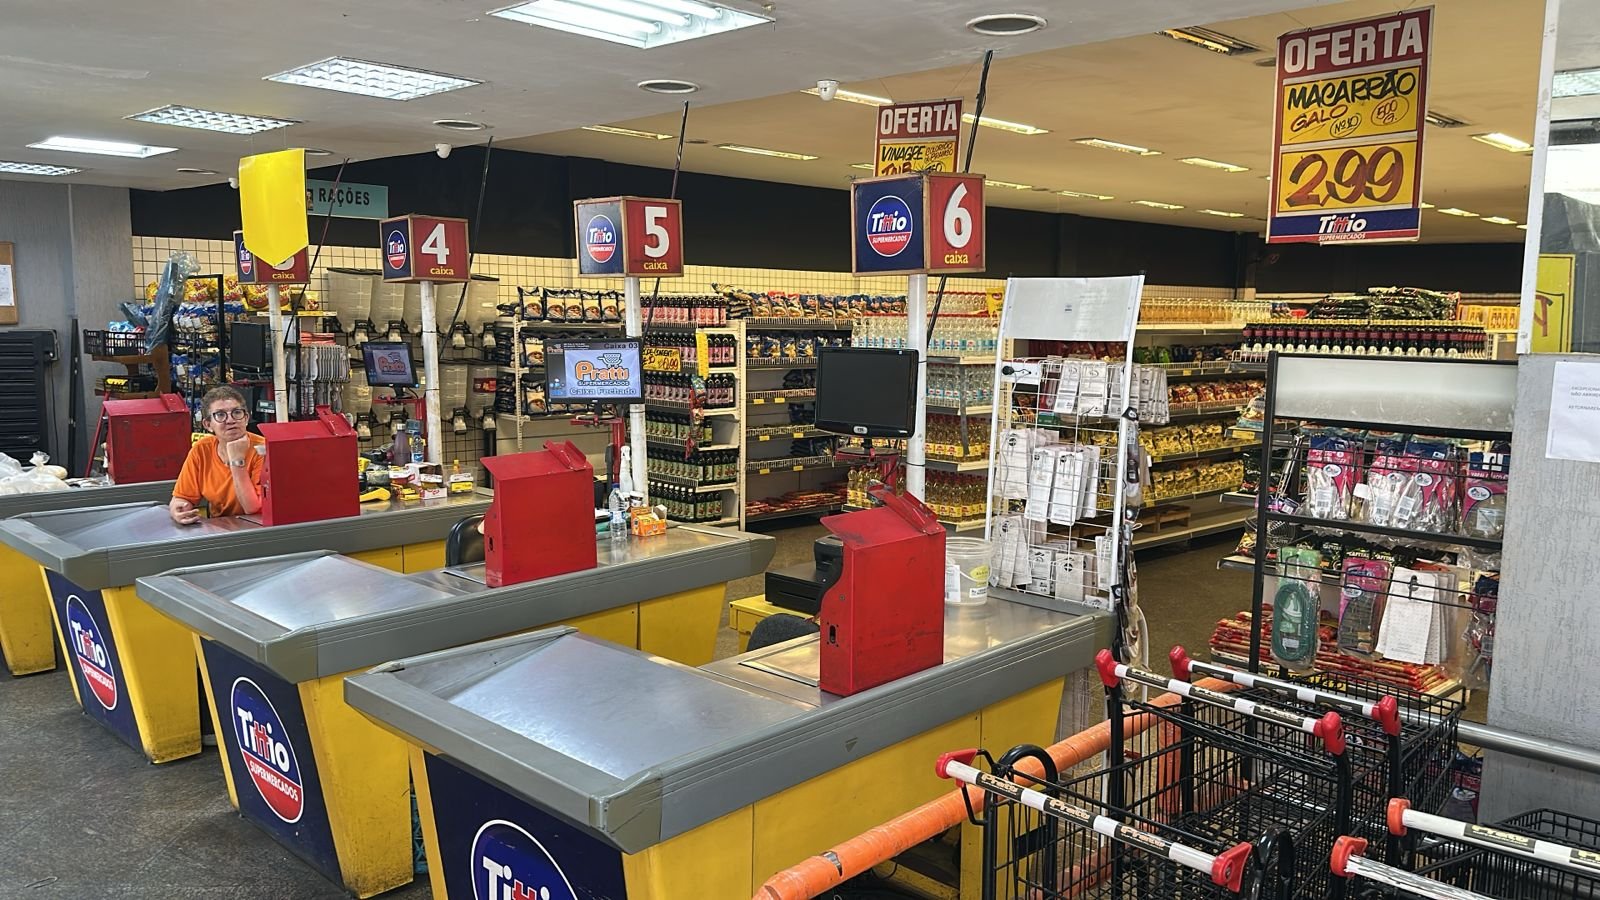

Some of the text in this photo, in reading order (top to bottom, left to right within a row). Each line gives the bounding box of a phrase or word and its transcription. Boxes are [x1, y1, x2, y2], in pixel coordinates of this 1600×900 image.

[1284, 17, 1423, 74] OFERTA
[1287, 69, 1416, 111] MACARRÃO
[880, 104, 957, 135] OFERTA
[1290, 104, 1348, 132] GALO
[1376, 99, 1398, 119] 500
[881, 145, 925, 161] VINAGRE
[1285, 145, 1405, 207] 2,99
[319, 186, 370, 207] RAÇÕES
[943, 182, 972, 249] 6
[421, 223, 450, 265] 4
[644, 206, 670, 258] 5
[872, 235, 907, 244] SUPERMERCADOS
[1318, 232, 1366, 242] SUPERMERCADOS
[643, 259, 668, 270] caixa
[944, 251, 968, 264] caixa
[271, 271, 295, 280] caixa
[429, 265, 454, 276] caixa
[570, 387, 595, 395] Caixa
[82, 660, 114, 692] SUPERMERCADOS
[249, 760, 299, 802] SUPERMERCADOS
